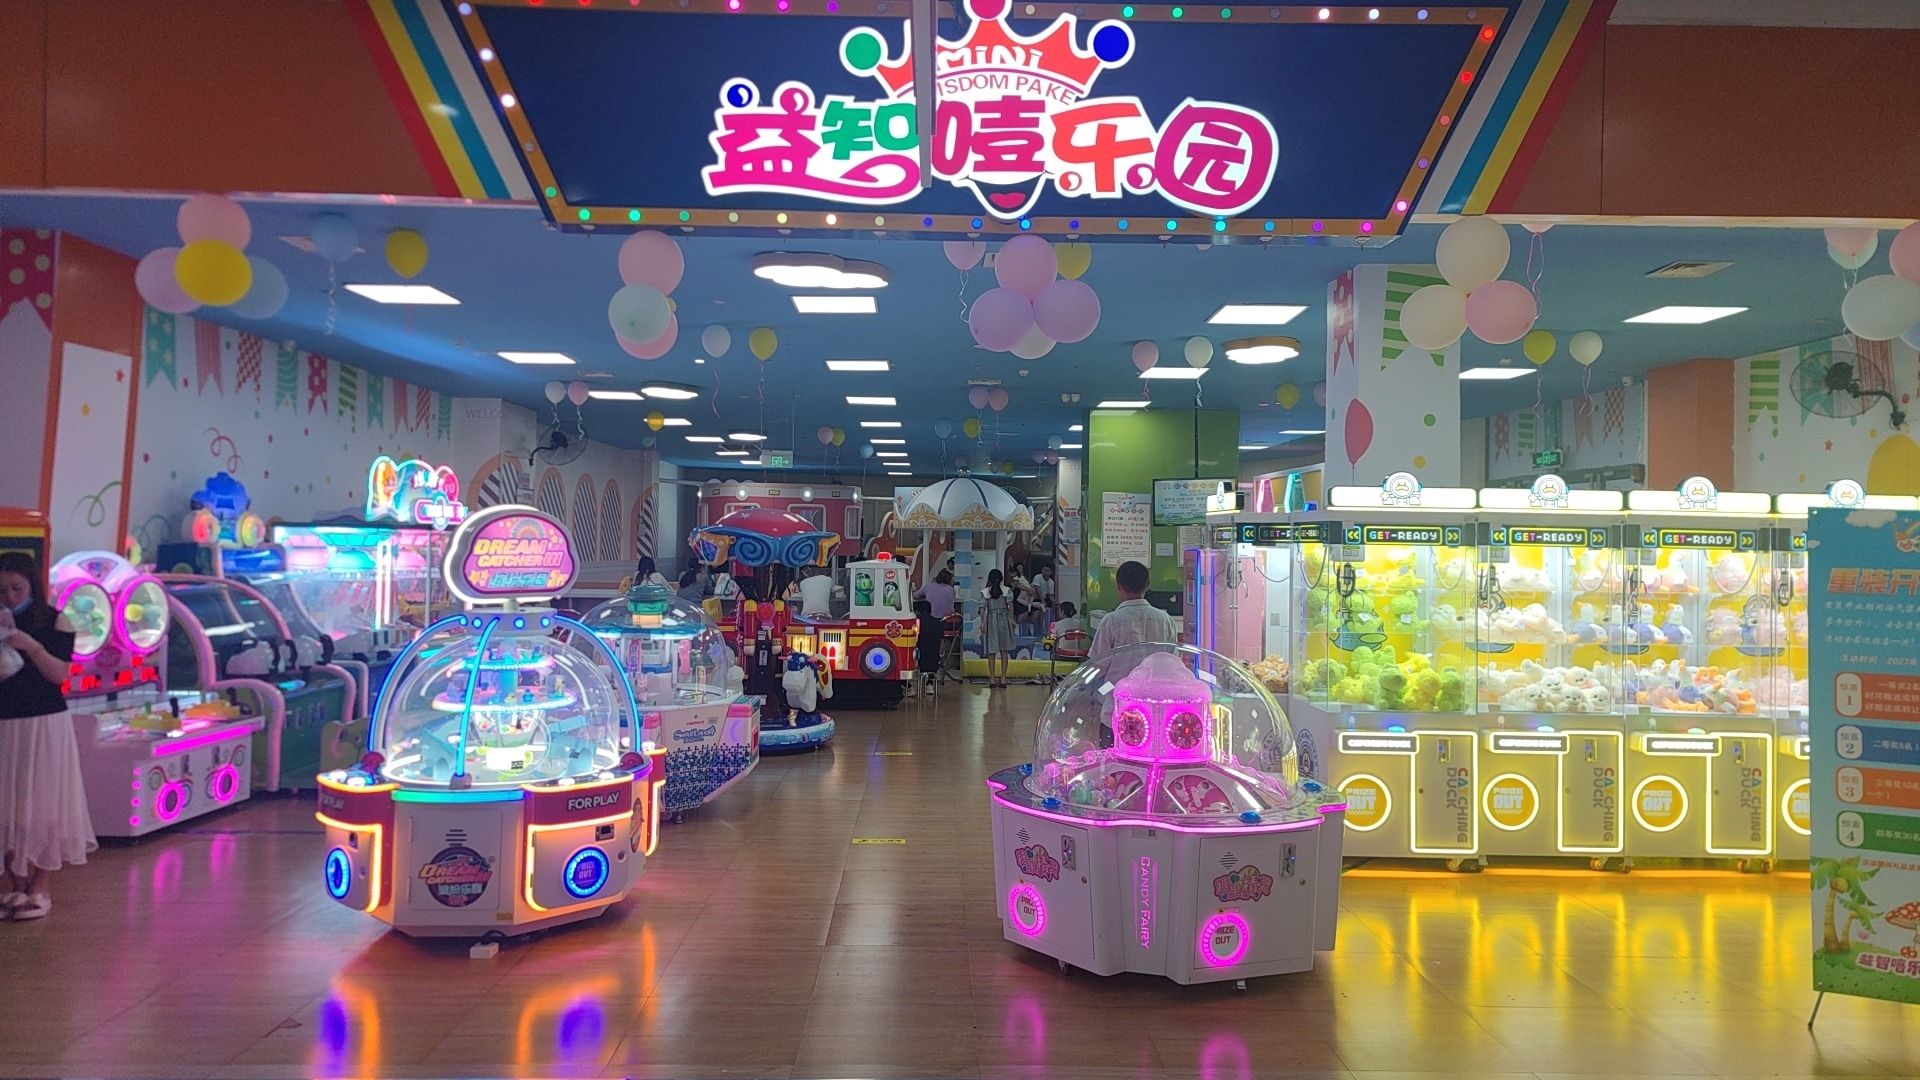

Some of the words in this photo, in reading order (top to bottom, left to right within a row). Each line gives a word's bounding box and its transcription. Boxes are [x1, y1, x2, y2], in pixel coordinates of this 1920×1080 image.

[936, 73, 1009, 96] ISDOM
[1369, 530, 1437, 541] GET-READY
[1515, 531, 1583, 542] GET-READY
[1665, 533, 1732, 544] GET-READY
[473, 538, 549, 556] DREAM
[1846, 695, 1853, 706] 1
[1845, 743, 1855, 754] 2
[1446, 767, 1458, 809] DUCK
[1592, 767, 1604, 809] DUCK
[1740, 767, 1751, 809] DUCK
[1845, 786, 1855, 798] 3
[1846, 831, 1855, 842] 4
[1140, 856, 1151, 907] CANDY
[1023, 906, 1036, 917] OUT
[1140, 909, 1151, 950] FAIRY
[1215, 935, 1231, 945] OUT
